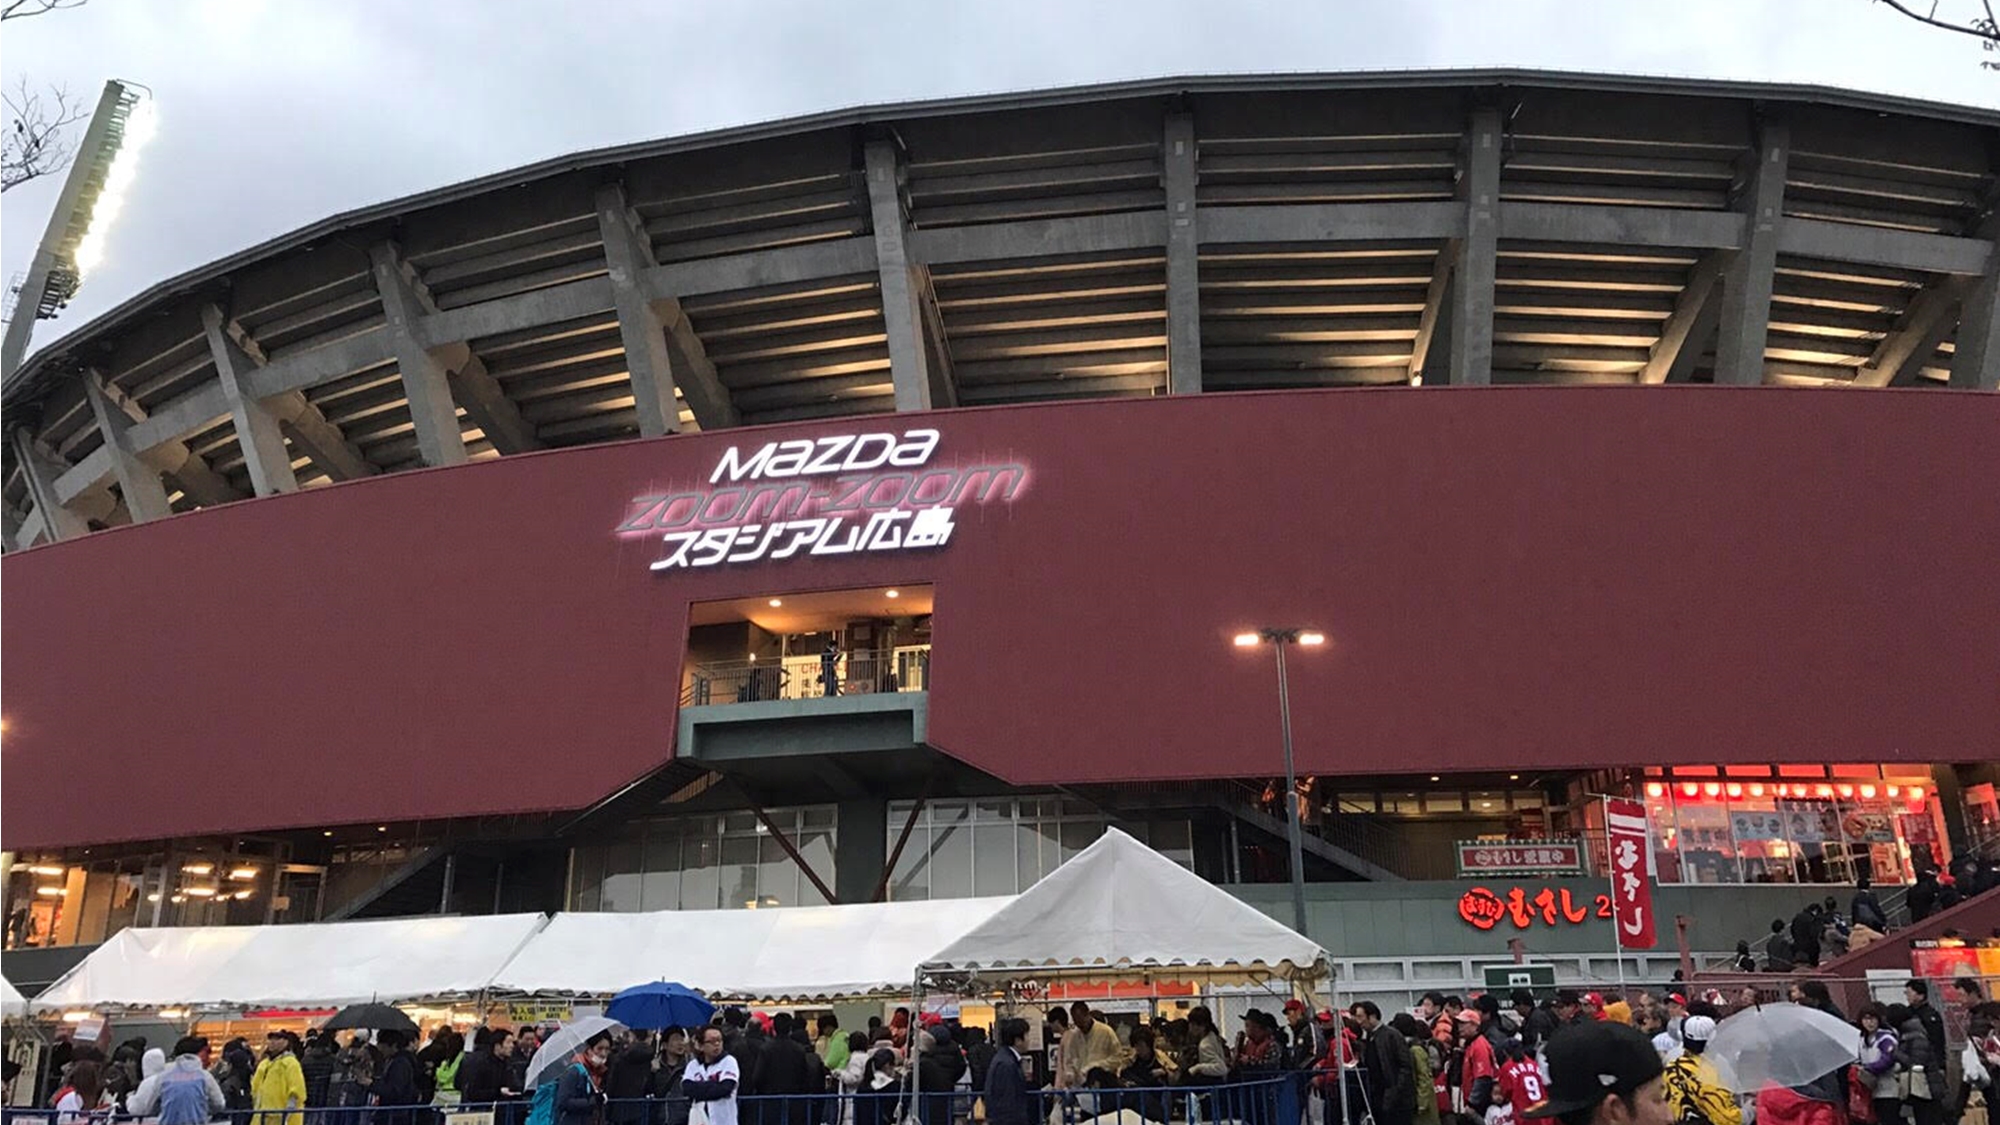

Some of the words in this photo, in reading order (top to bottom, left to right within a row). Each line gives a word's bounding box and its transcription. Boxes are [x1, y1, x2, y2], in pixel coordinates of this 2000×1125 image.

[650, 505, 956, 571] スタジアム広島
[1507, 886, 1587, 928] むさし
[1523, 1076, 1541, 1101] 9
